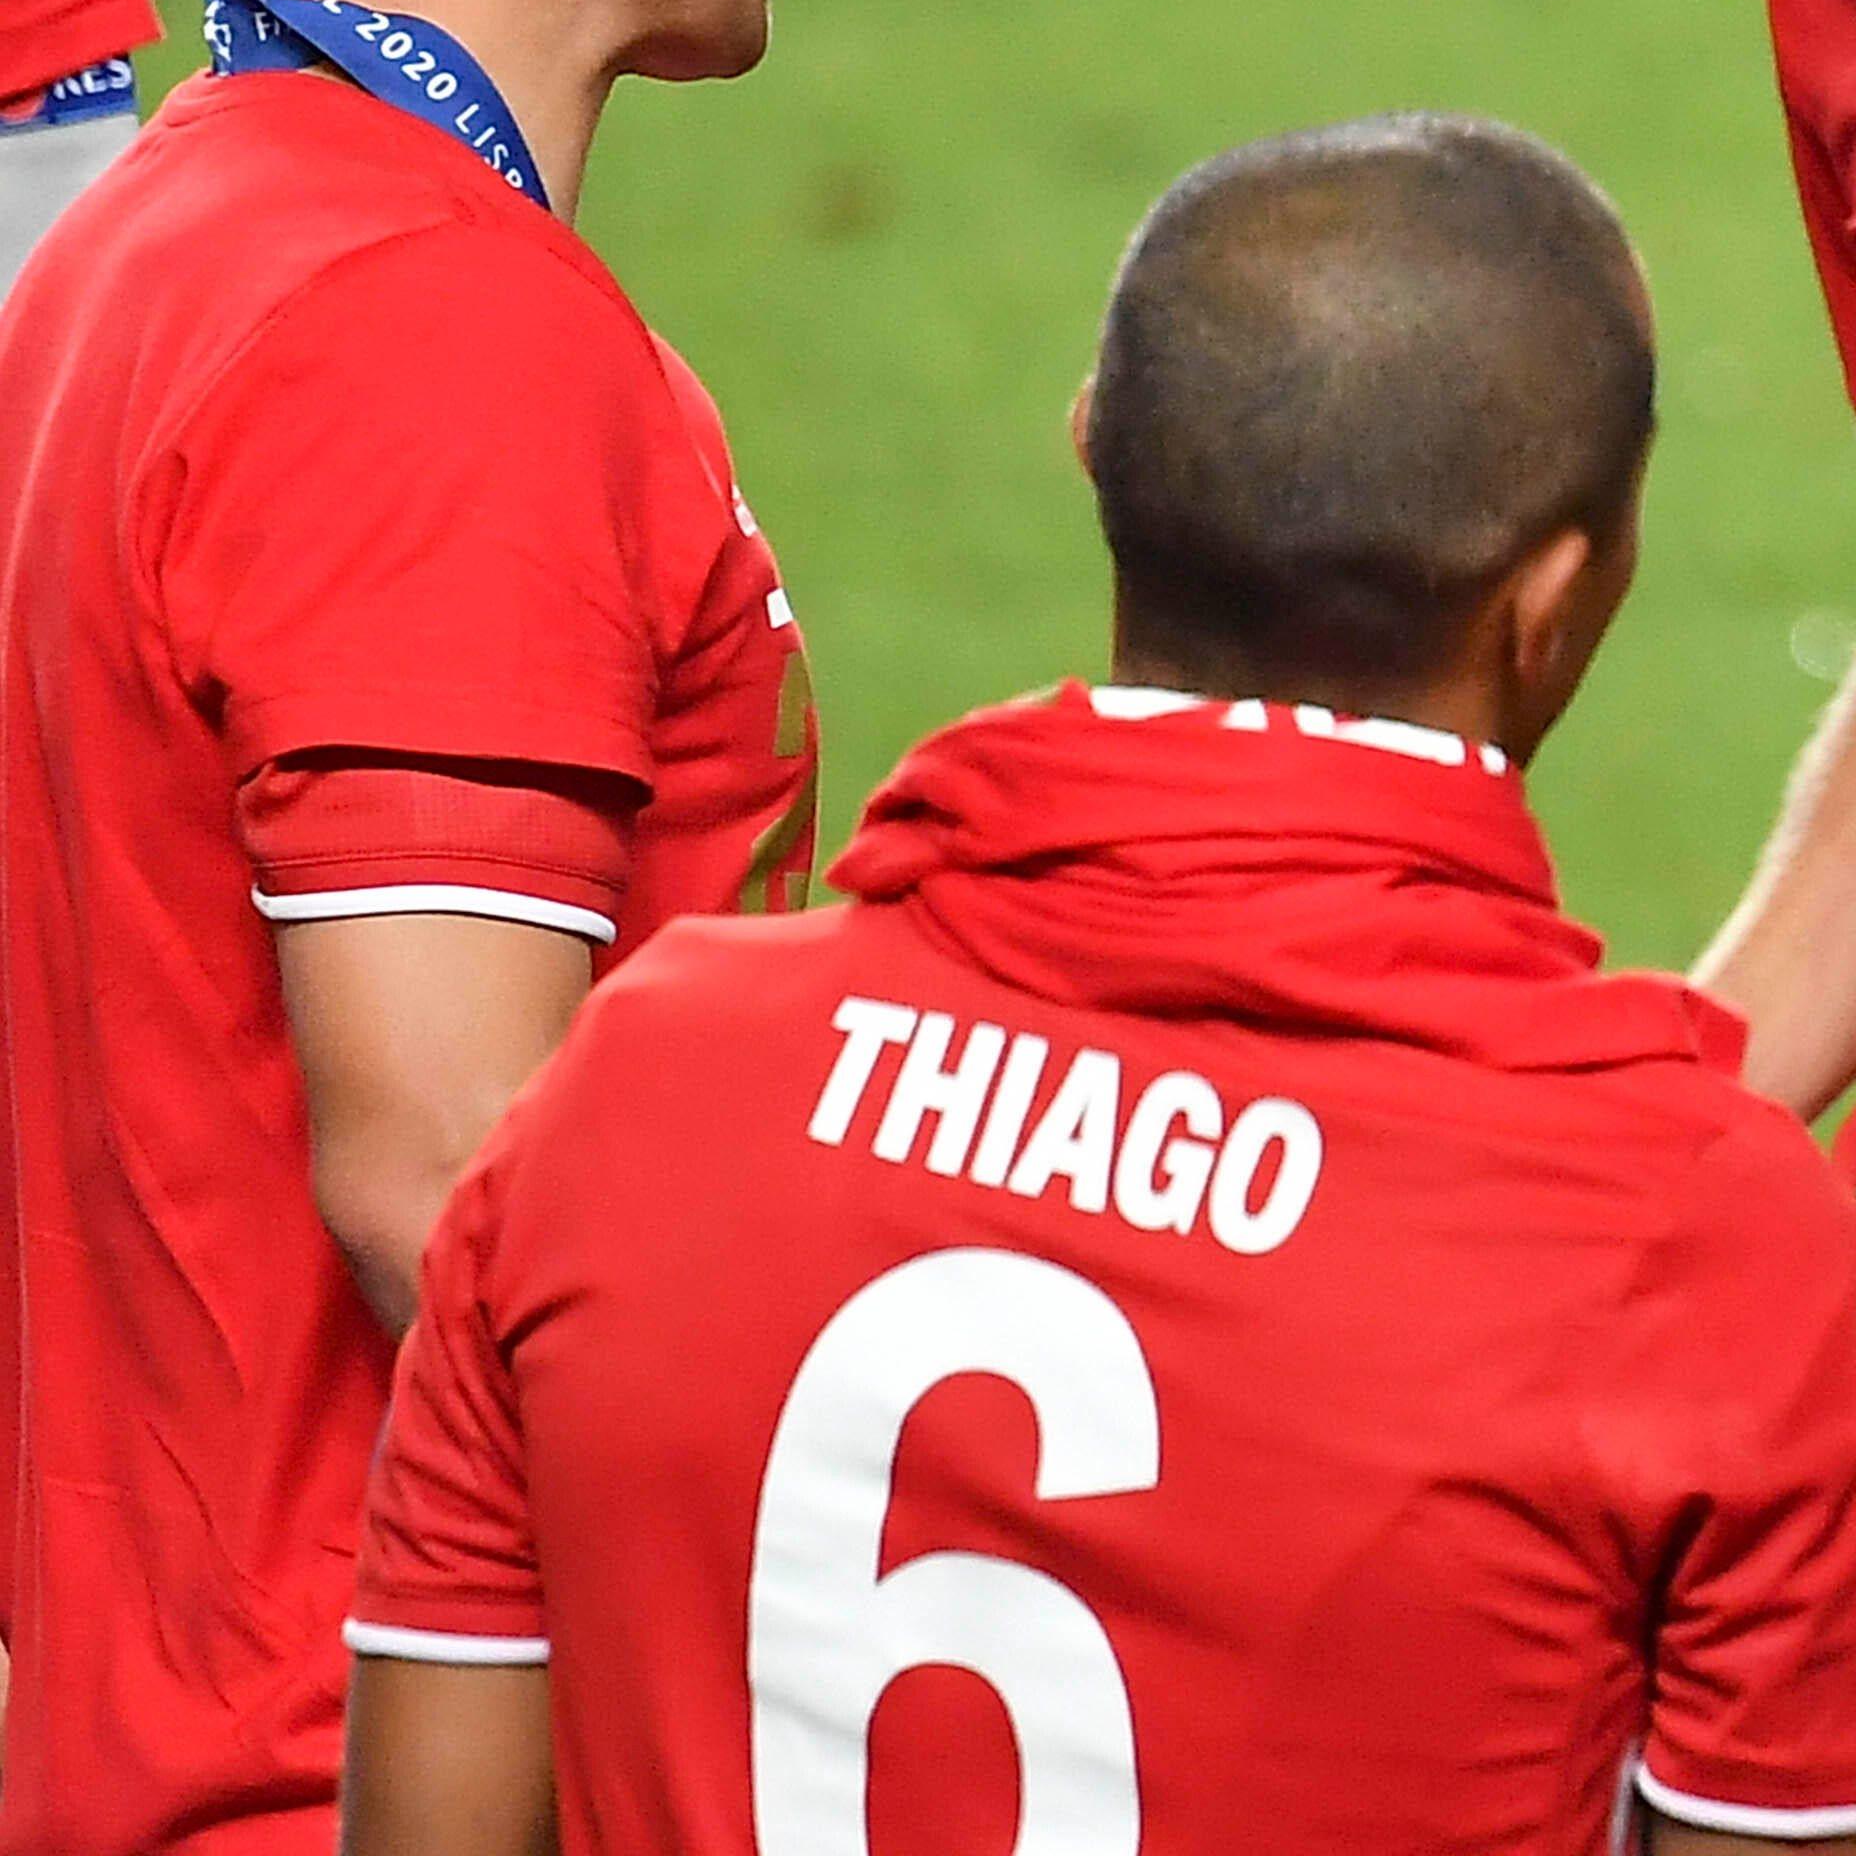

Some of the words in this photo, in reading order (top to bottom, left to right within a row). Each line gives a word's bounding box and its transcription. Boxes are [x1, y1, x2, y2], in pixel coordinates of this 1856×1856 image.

[354, 12, 458, 101] 2020
[806, 995, 1326, 1255] THIAGO
[745, 1243, 1163, 1856] 6
